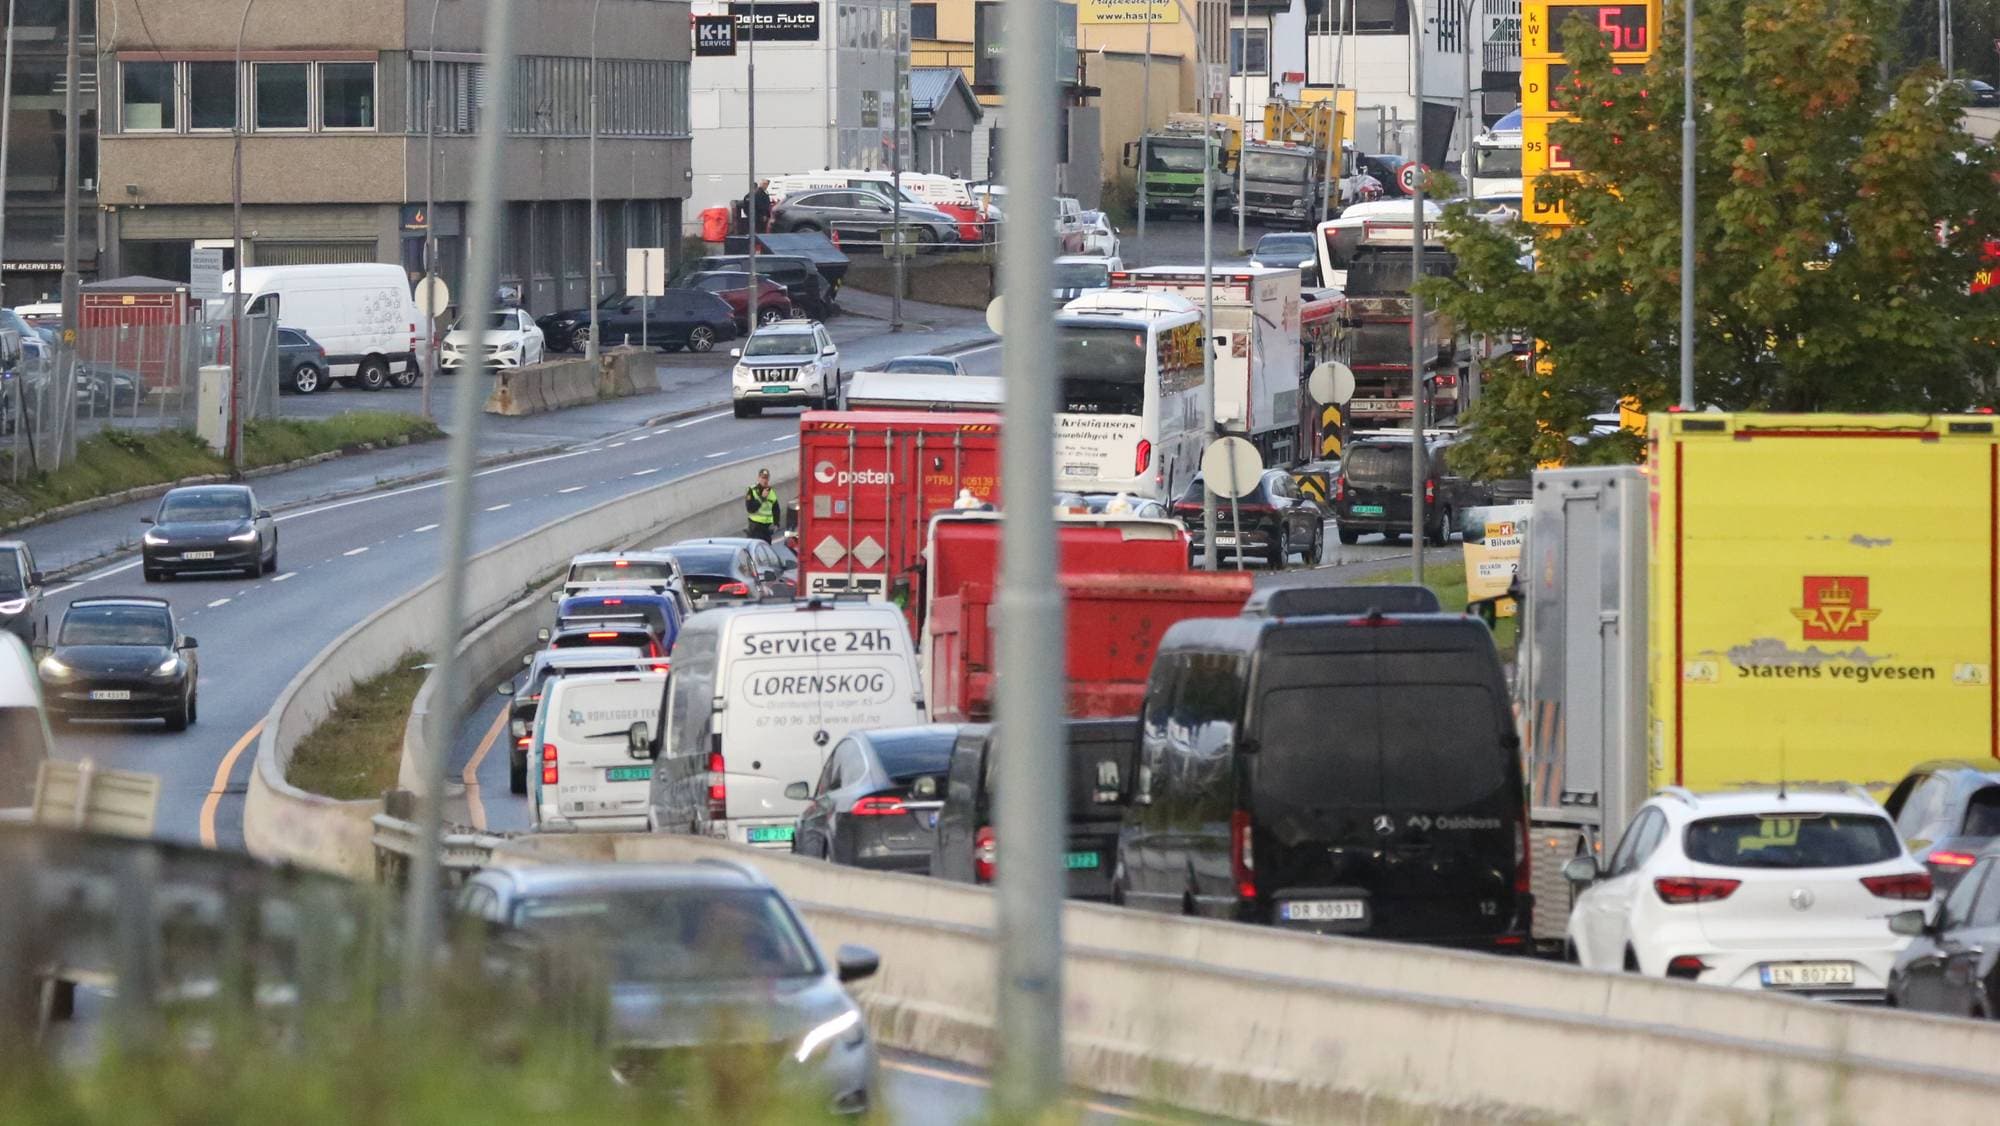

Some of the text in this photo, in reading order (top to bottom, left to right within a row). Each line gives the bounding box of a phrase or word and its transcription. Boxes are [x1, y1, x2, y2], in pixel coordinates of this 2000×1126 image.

[777, 14, 815, 24] Auto
[700, 24, 731, 40] K-H
[1529, 83, 1538, 93] D
[1527, 142, 1541, 152] 95
[838, 469, 894, 487] posten
[1491, 538, 1521, 548] Bilvask
[743, 630, 891, 656] Service 24h
[1738, 662, 1936, 683] Statens vegvesen
[1292, 903, 1360, 917] DR 90937
[1480, 901, 1497, 915] 12
[1775, 967, 1849, 982] EN 80722
